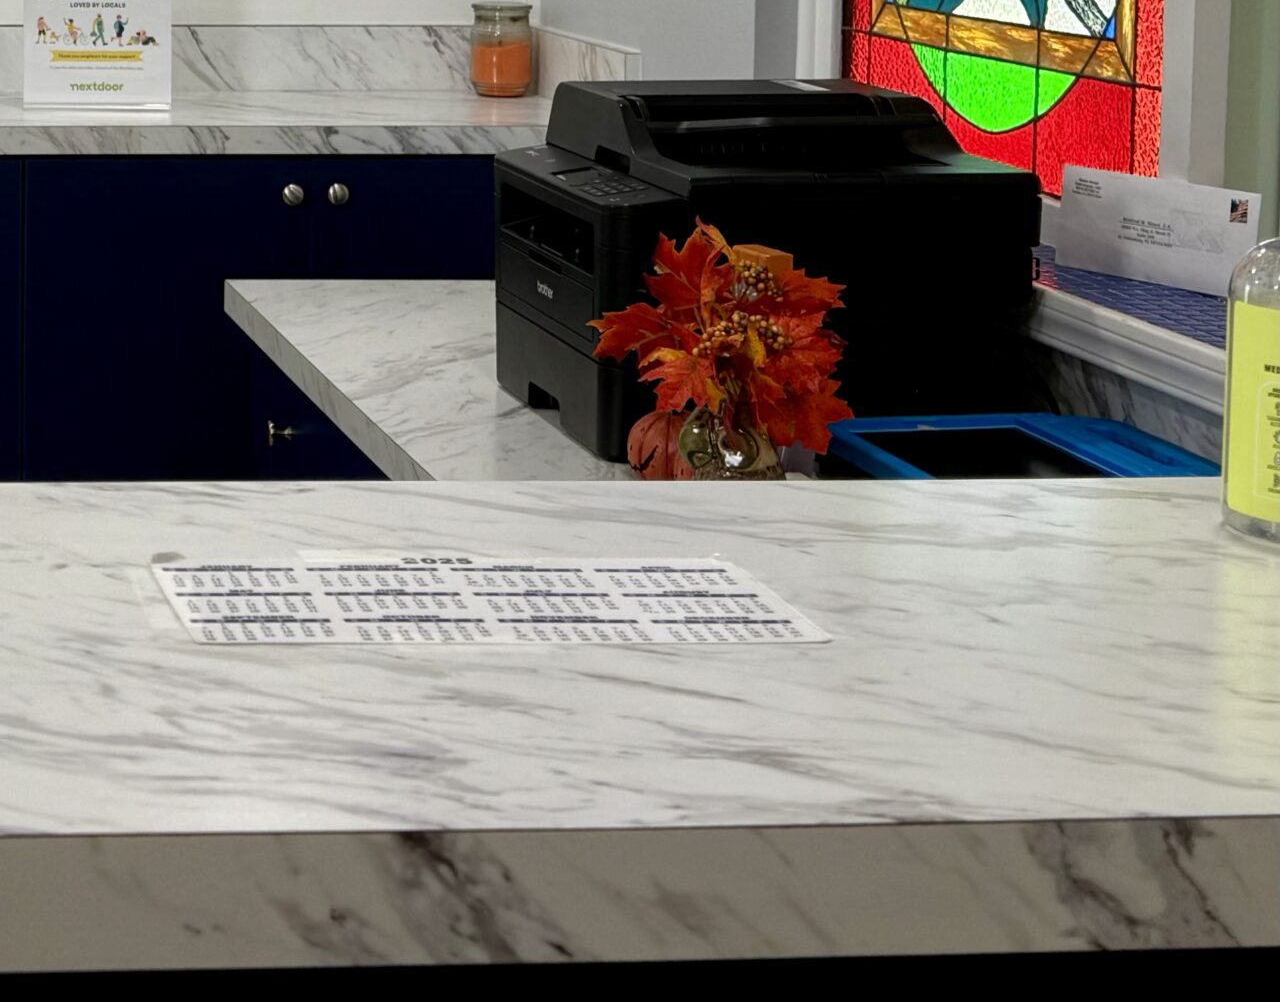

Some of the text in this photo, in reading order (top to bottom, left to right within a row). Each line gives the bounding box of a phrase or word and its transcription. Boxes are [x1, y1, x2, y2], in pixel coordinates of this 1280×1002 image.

[69, 81, 124, 91] nextdoor
[536, 279, 554, 299] brother
[400, 557, 473, 565] 2025
